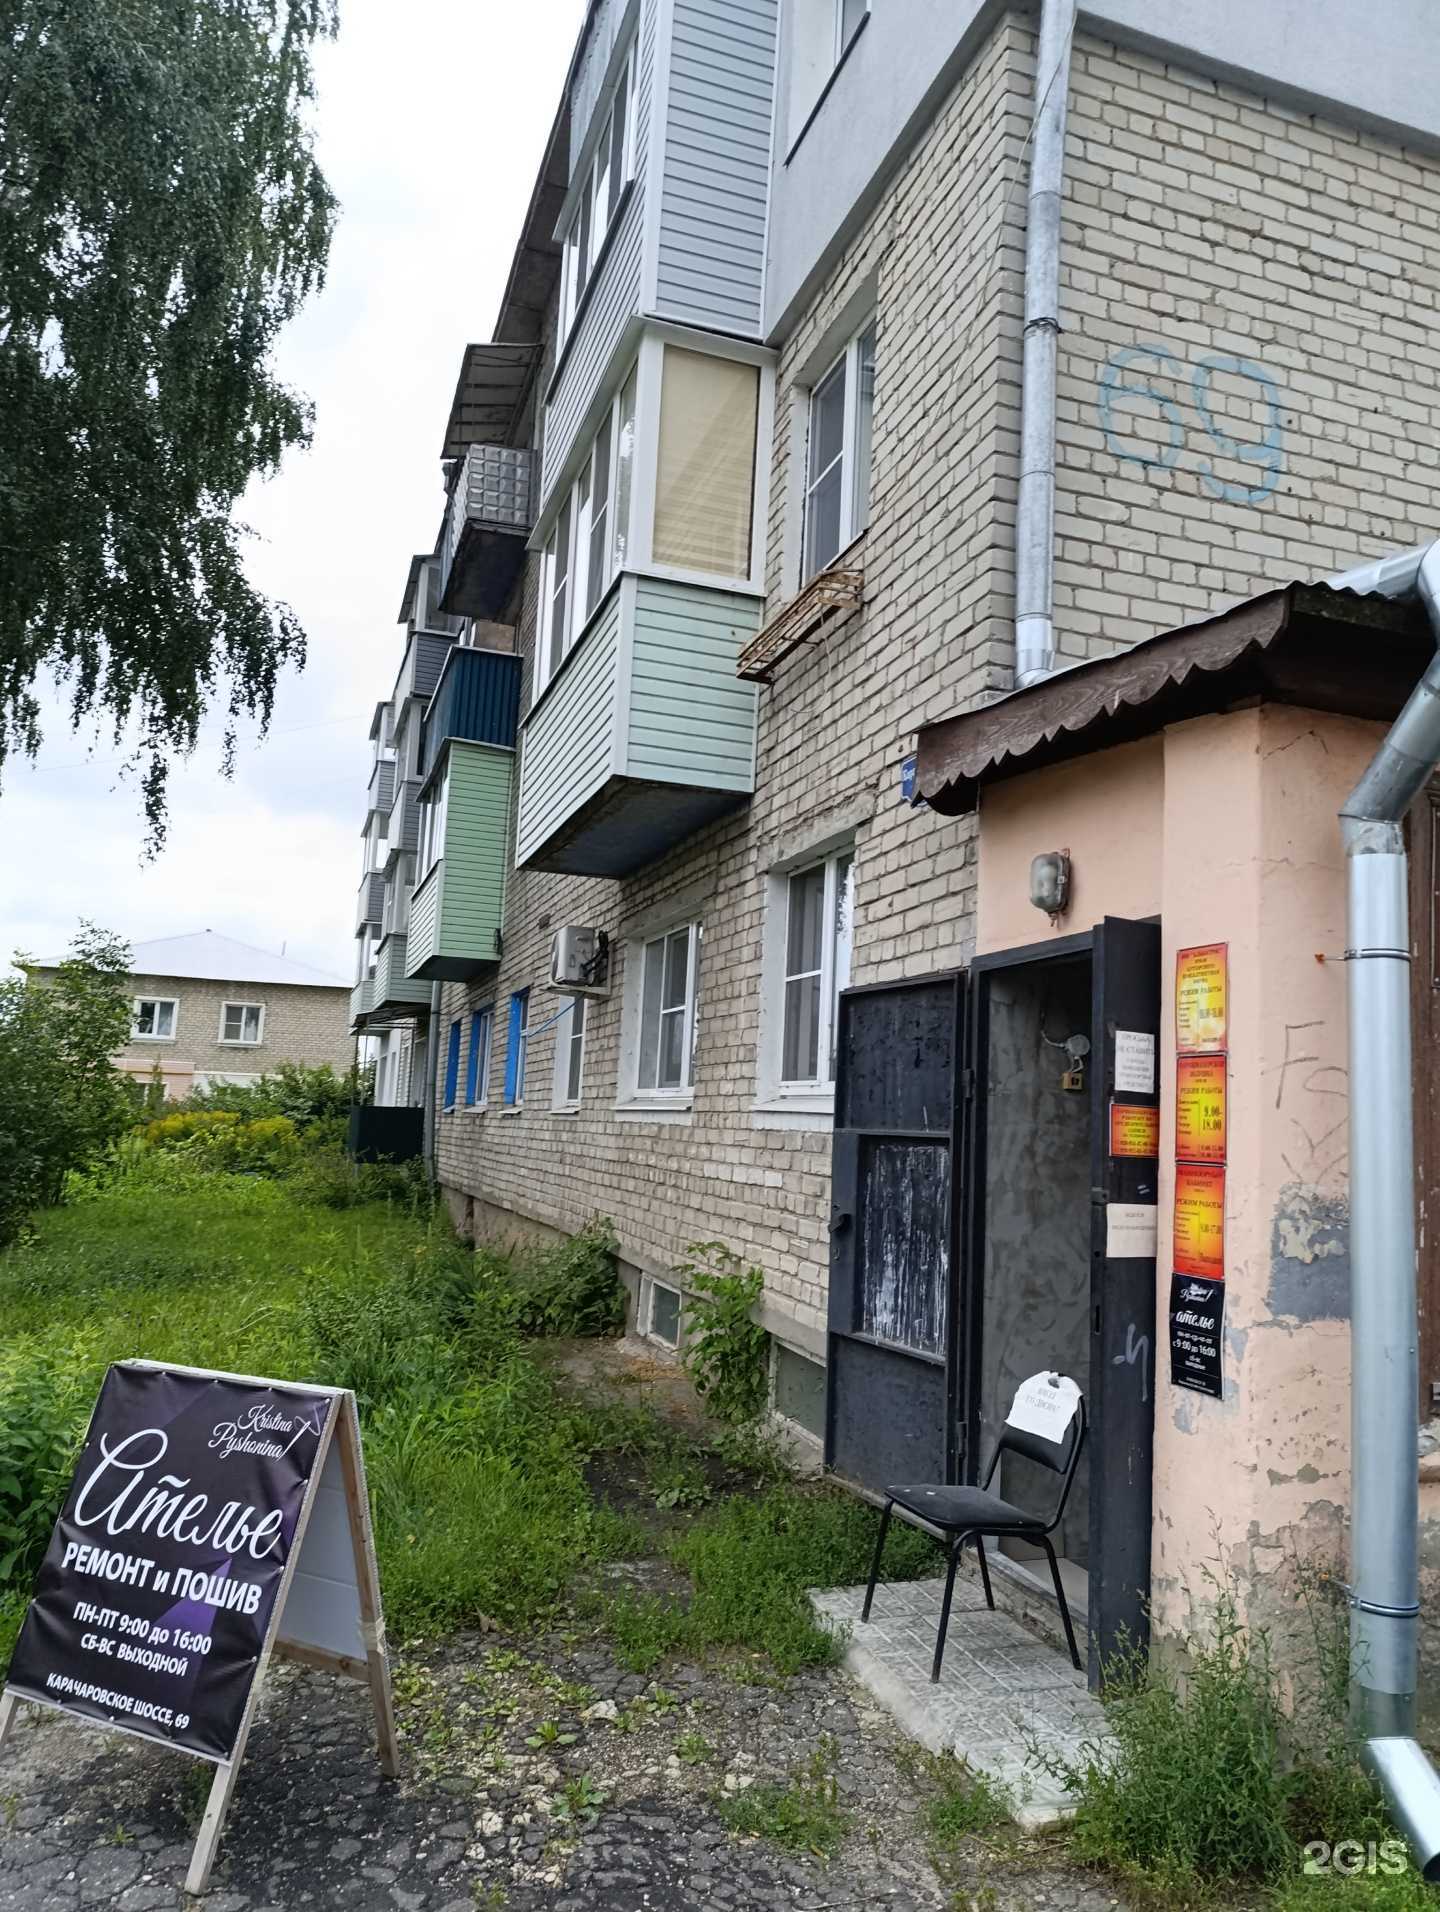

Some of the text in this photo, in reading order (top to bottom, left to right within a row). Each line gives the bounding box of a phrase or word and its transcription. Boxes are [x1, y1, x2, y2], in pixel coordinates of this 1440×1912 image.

[1098, 343, 1281, 504] 69
[1175, 1309, 1216, 1331] ателье
[208, 1422, 285, 1459] Pyshonina
[238, 1404, 293, 1432] Kristina
[74, 1428, 285, 1559] Ателье
[61, 1541, 263, 1615] РЕМОНТ и ПОШИВ
[73, 1601, 212, 1655] ПН-ПТ 9:00 до 16:00
[81, 1633, 189, 1677] СБ-ВС ВЫХОДНОЙ
[46, 1673, 190, 1729] КАРАЧАРОВСКОЕ ШОССЕ, 69
